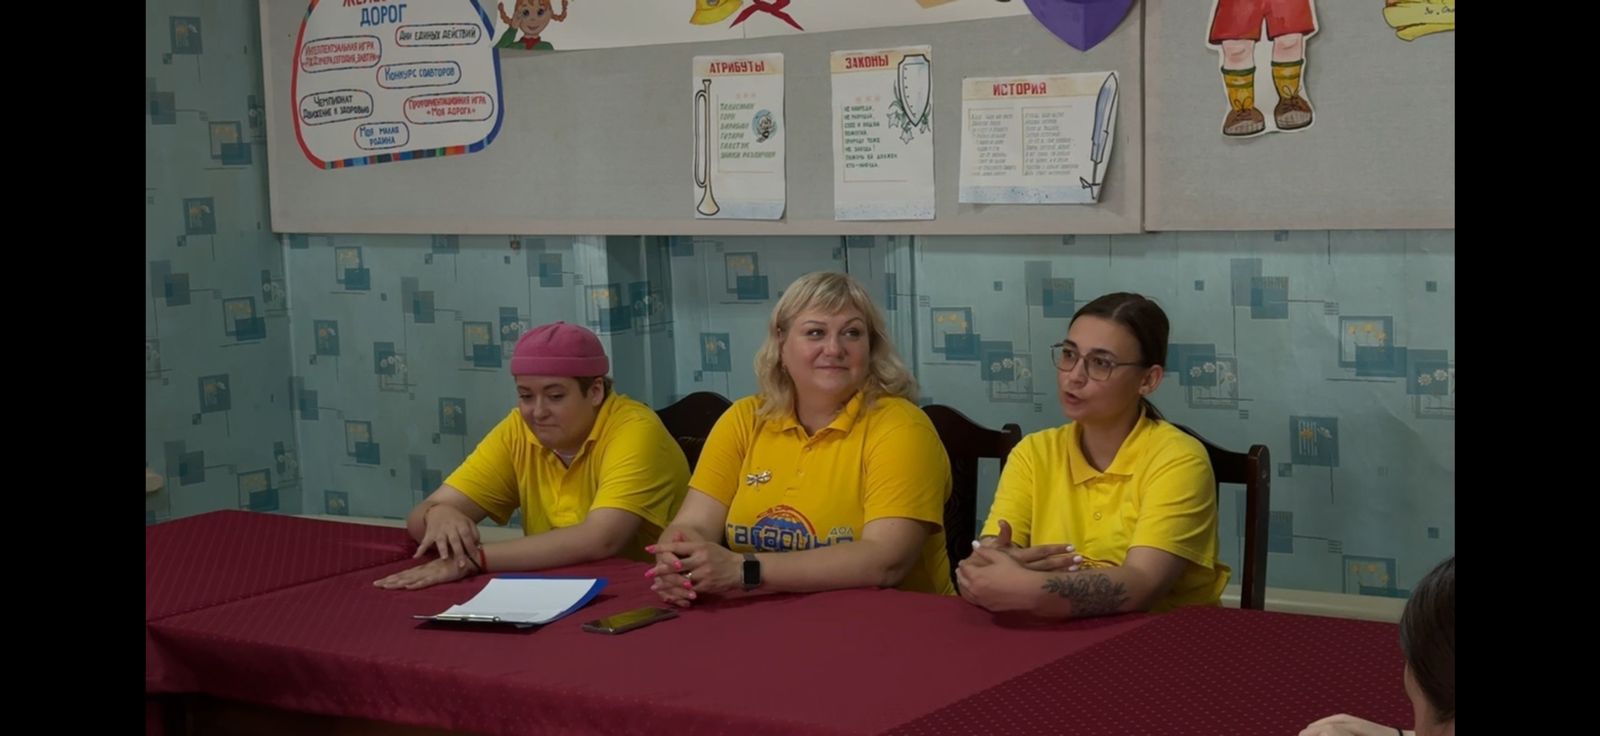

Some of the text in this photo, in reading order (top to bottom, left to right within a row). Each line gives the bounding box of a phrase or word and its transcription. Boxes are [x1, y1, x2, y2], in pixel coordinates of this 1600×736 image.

[360, 4, 407, 27] ДОРОГ
[709, 60, 765, 73] АТРИБУТЫ
[845, 54, 889, 69] ЗАКОНЫ
[385, 67, 417, 80] КОНКУРС
[993, 82, 1047, 96] ИСТОРИЯ
[472, 95, 487, 105] ИГРА
[369, 136, 396, 147] РОДИНА
